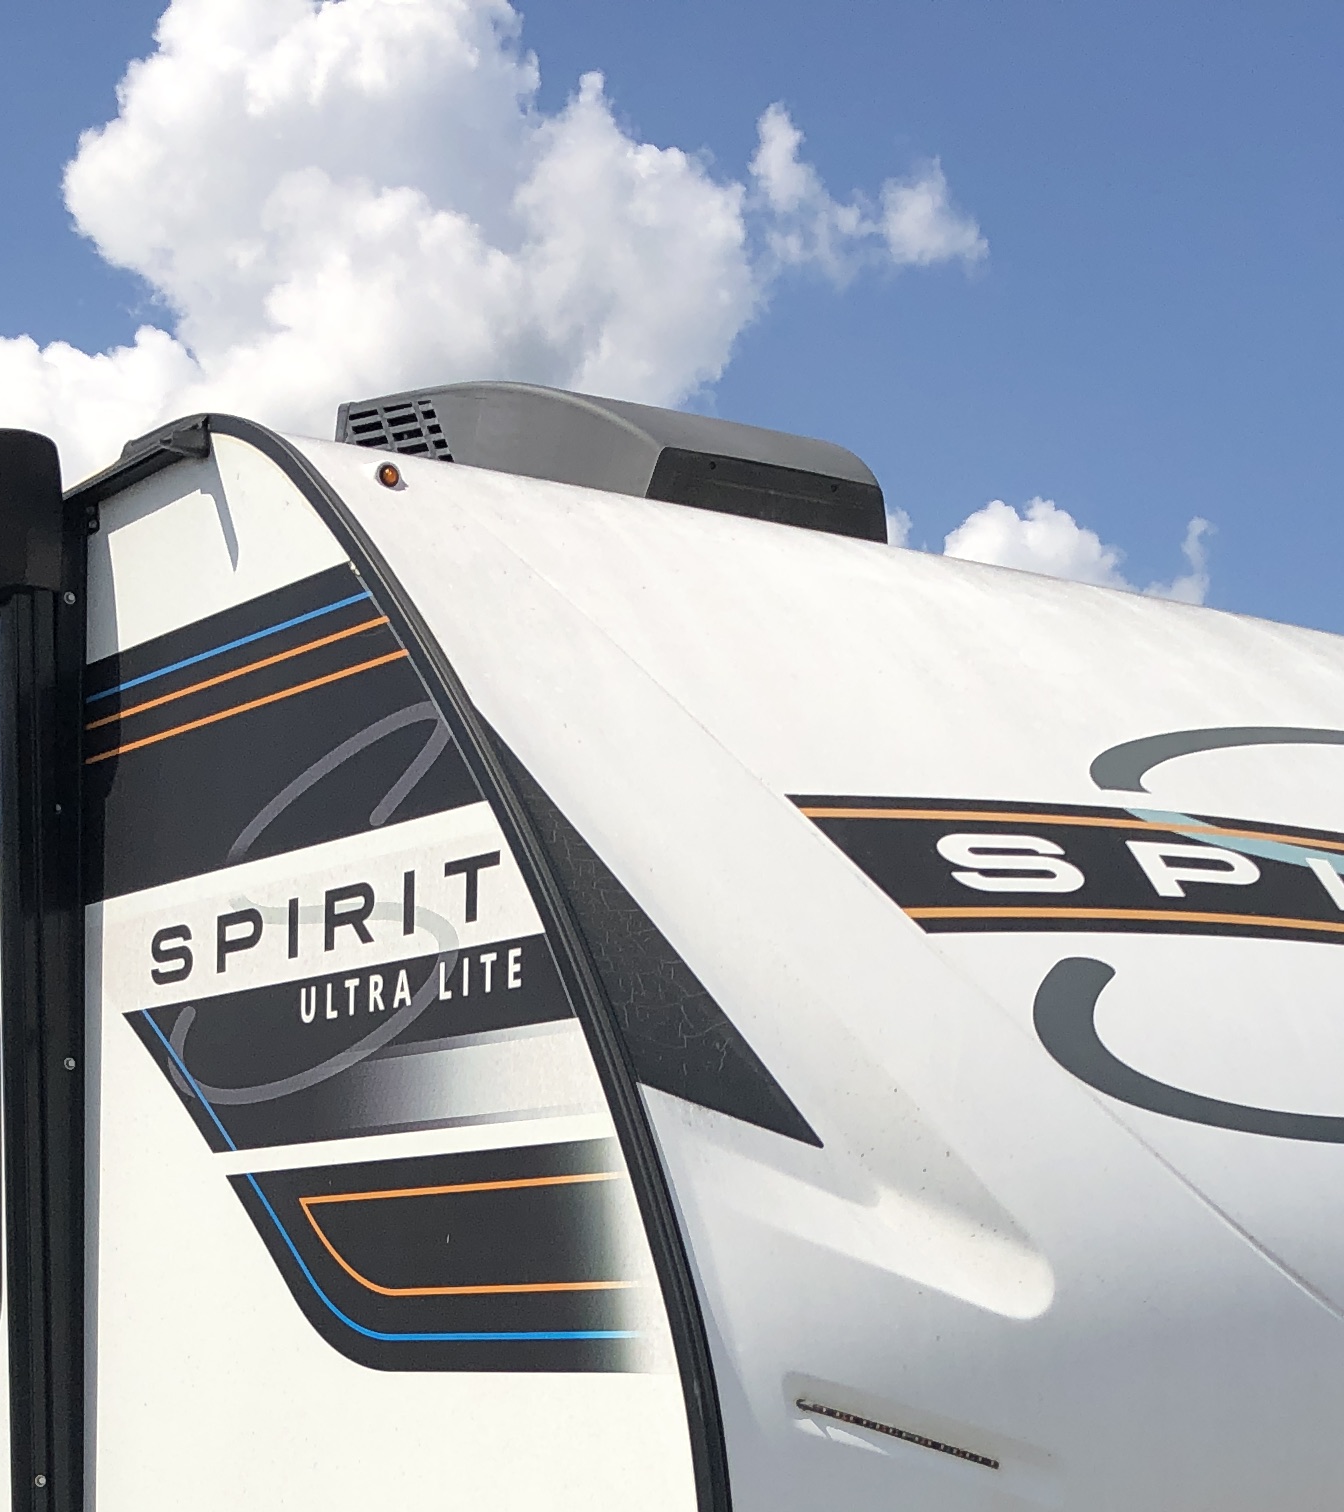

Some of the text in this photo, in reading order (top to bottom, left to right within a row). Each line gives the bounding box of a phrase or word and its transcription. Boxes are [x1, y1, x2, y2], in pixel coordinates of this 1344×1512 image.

[150, 849, 502, 986] SPIRIT
[299, 947, 524, 1024] ULTRA LITE
